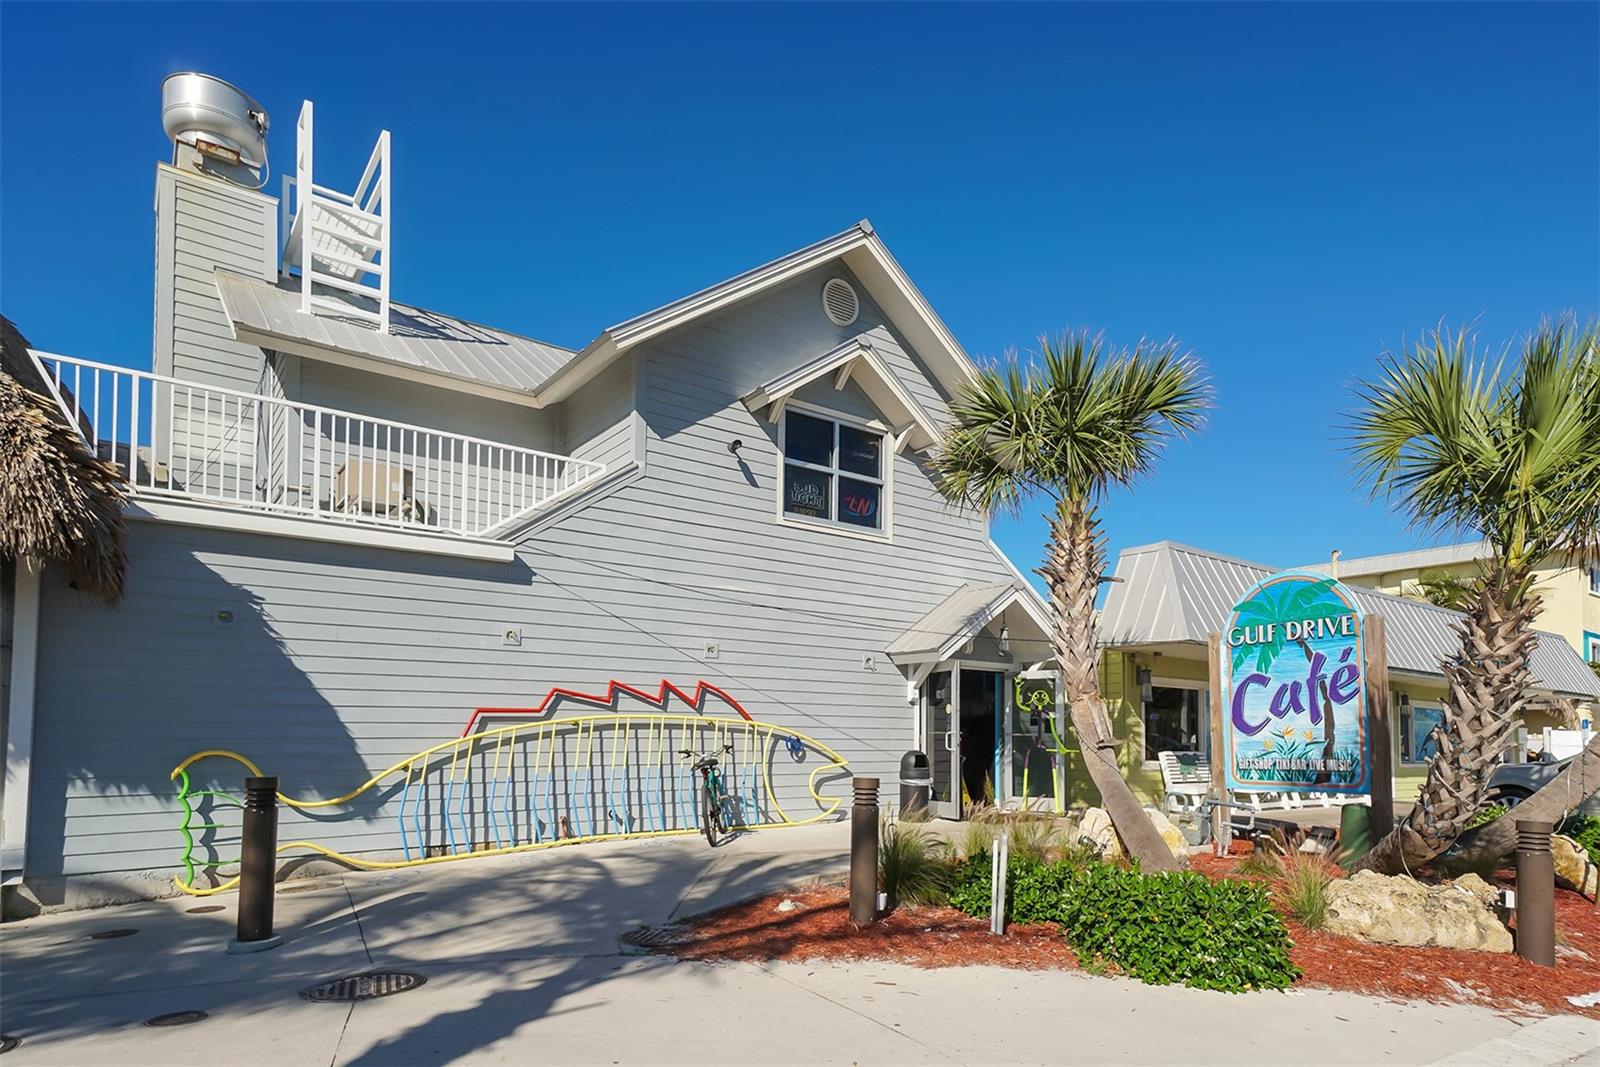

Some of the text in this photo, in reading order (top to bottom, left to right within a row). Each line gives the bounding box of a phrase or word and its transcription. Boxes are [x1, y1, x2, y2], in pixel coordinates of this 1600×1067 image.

[1227, 615, 1356, 647] GULF DRIVE
[1231, 646, 1361, 737] Café
[1238, 759, 1352, 771] GIFT SHOP TIKI BAR LIVE MUSIC
